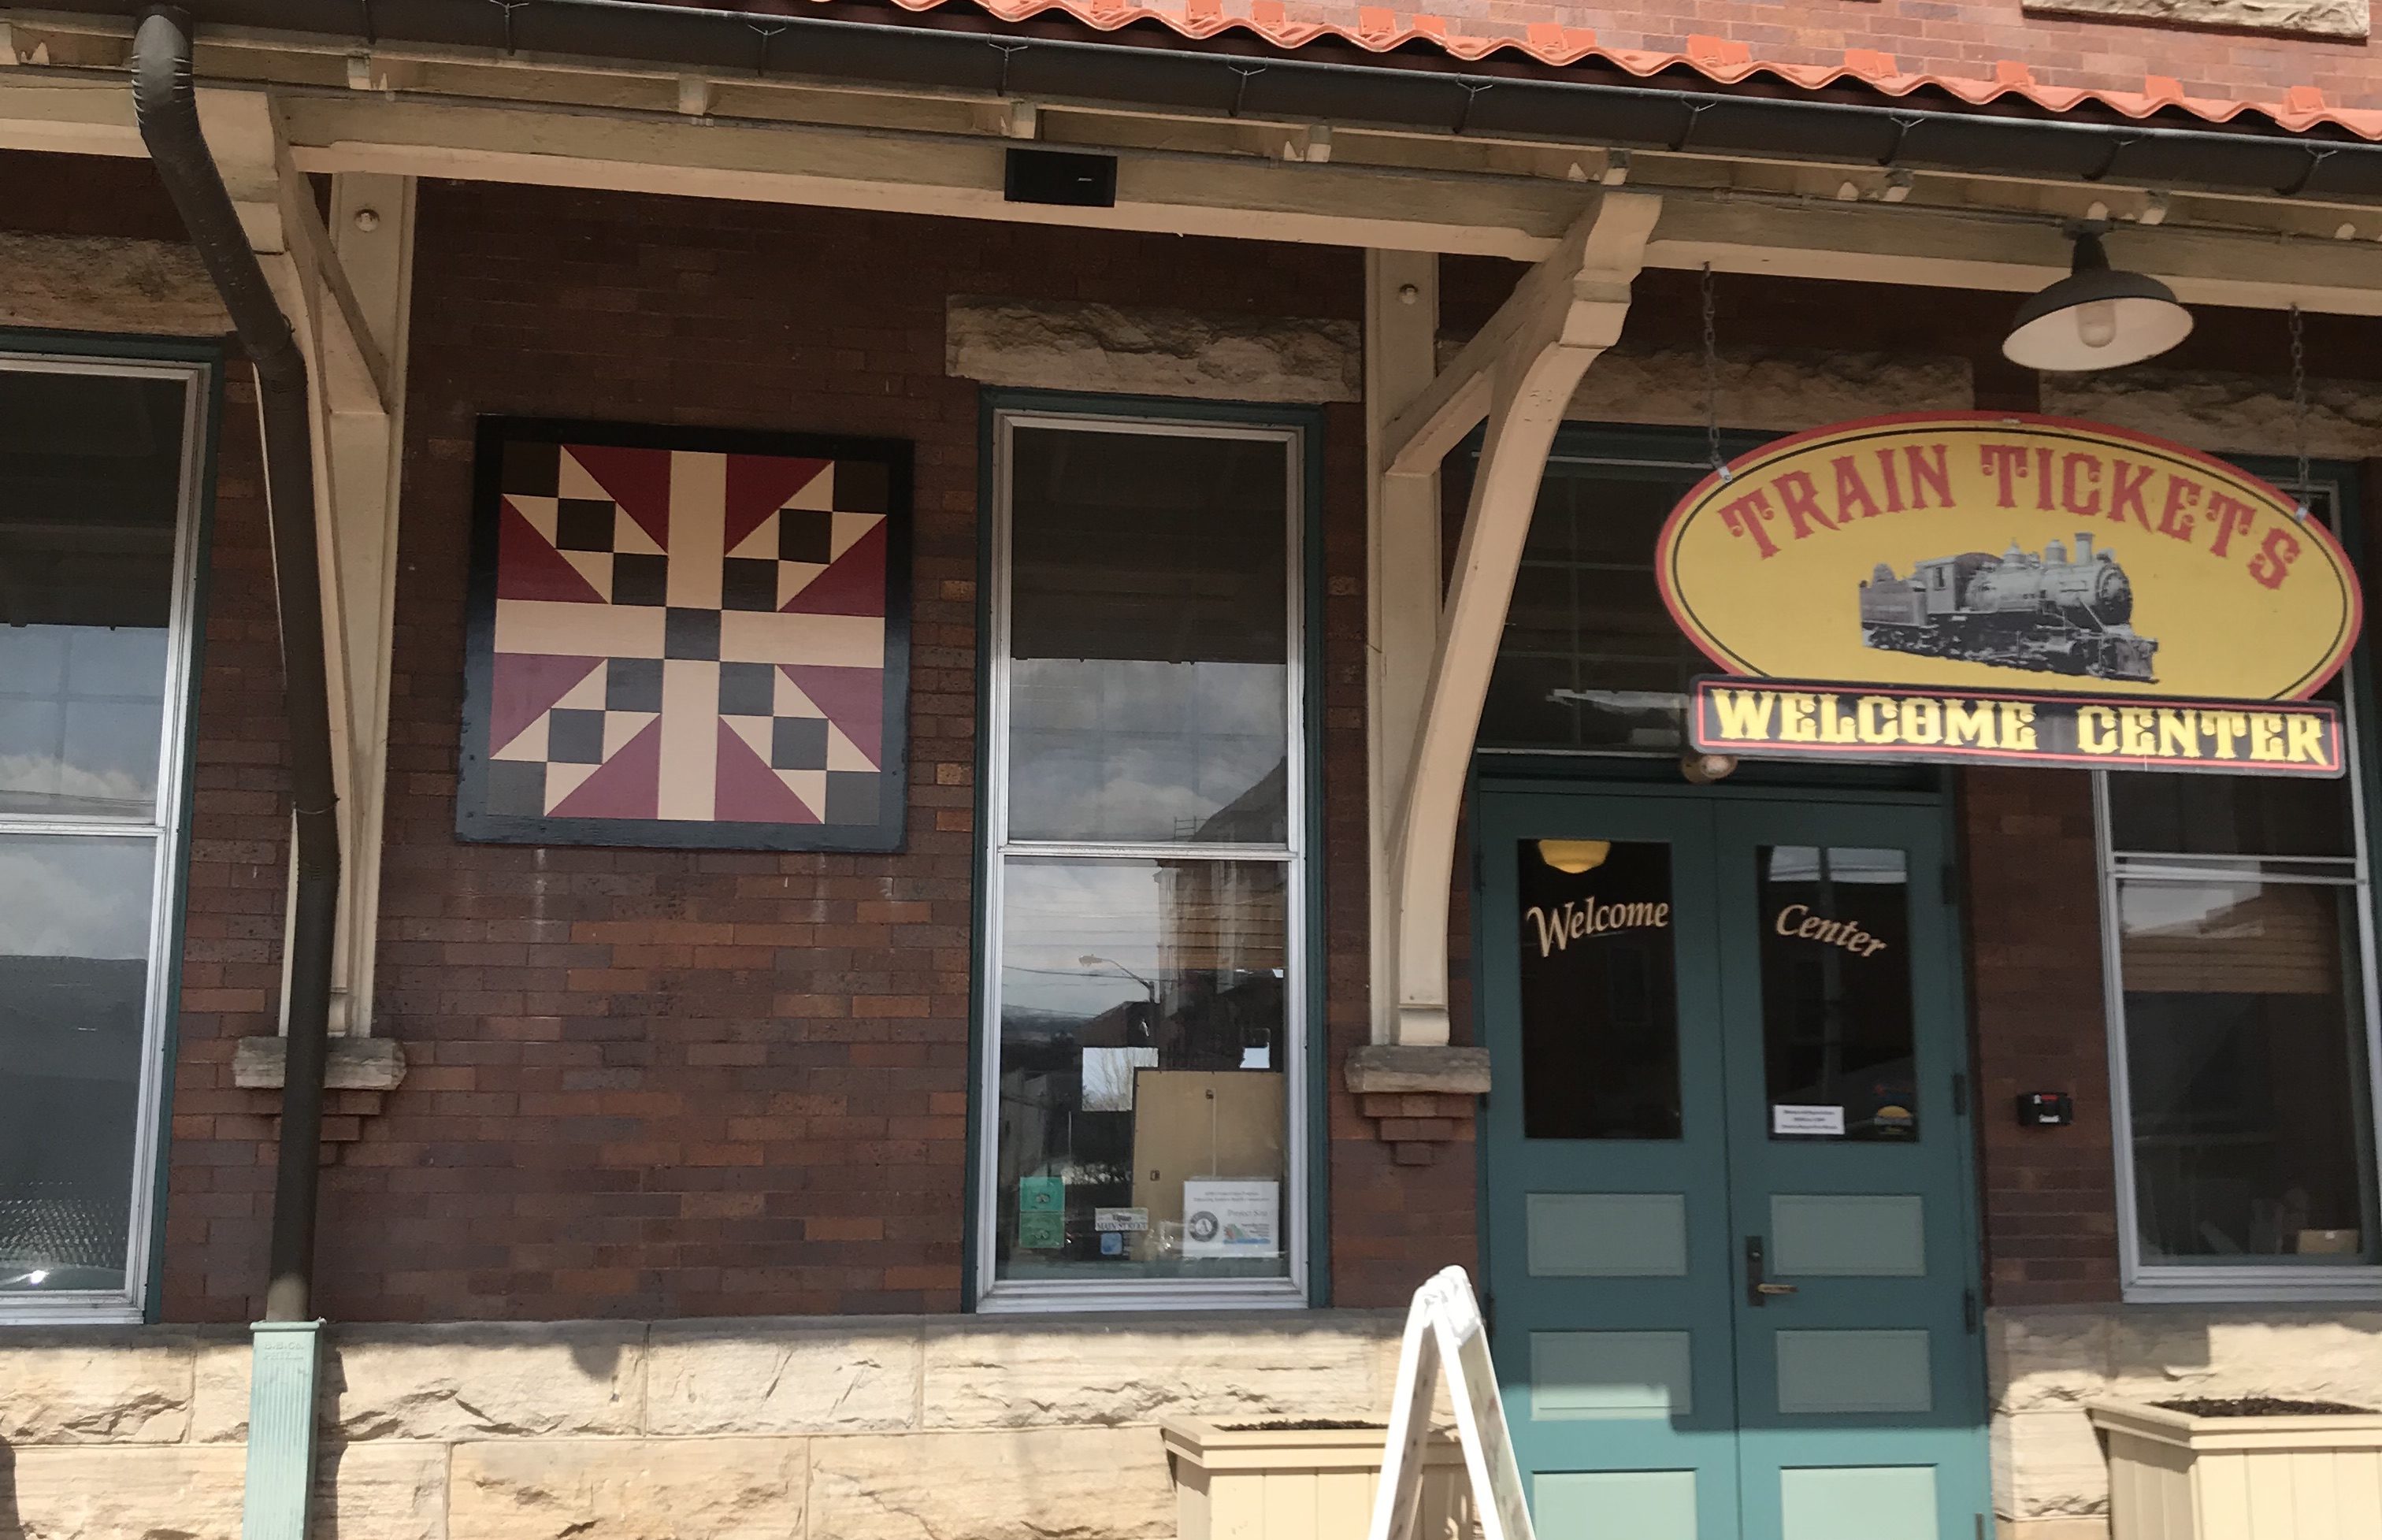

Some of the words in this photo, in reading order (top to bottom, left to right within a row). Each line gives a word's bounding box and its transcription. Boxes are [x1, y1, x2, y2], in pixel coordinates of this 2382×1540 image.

[1717, 443, 1955, 558] TRAIN
[1979, 443, 2301, 589] TICKETS
[1711, 688, 2038, 751] WELCOME
[2076, 705, 2328, 766] CENTER
[1526, 896, 1669, 958] Welcome
[1775, 904, 1887, 957] Center
